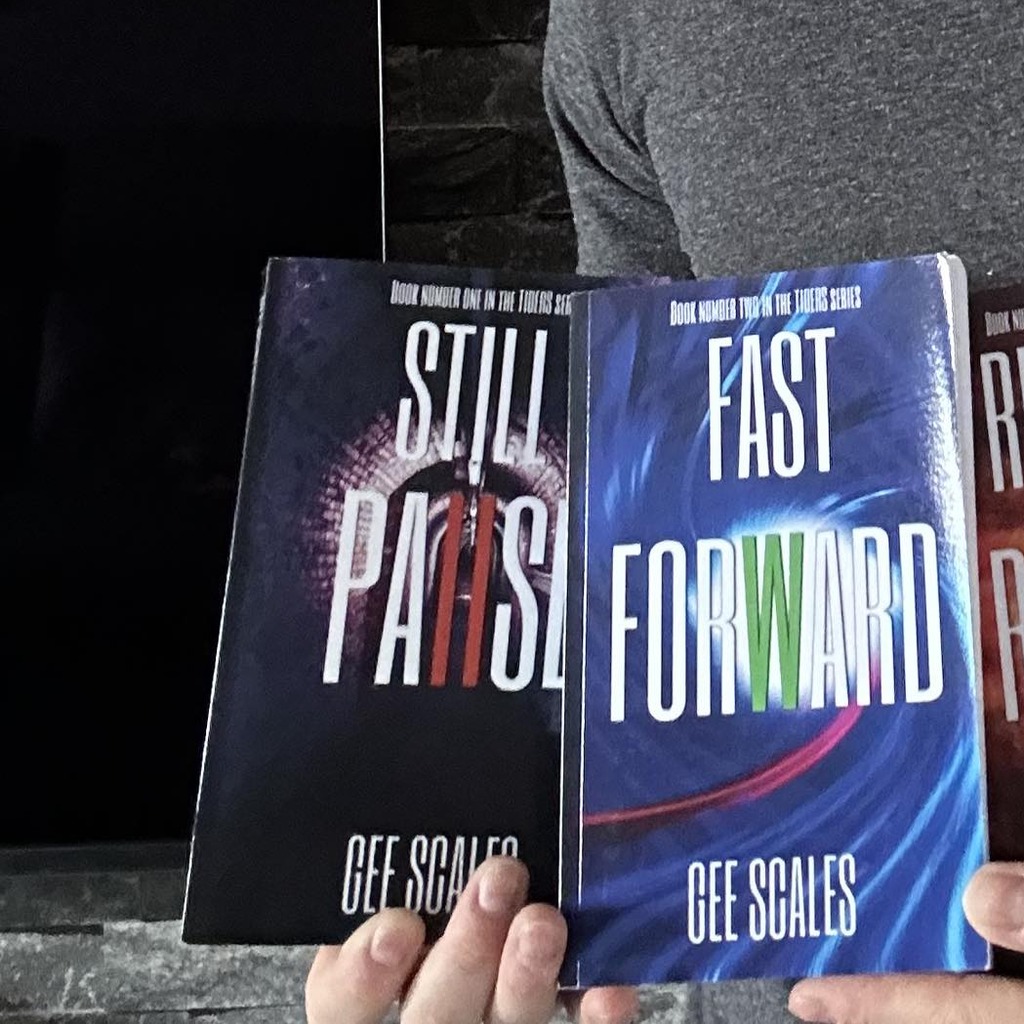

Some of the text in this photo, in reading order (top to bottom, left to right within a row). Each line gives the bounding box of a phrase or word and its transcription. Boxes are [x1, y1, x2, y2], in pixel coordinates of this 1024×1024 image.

[390, 279, 419, 305] BOOK
[420, 283, 461, 308] NUMBER
[462, 287, 482, 311] ONE
[484, 288, 496, 311] IN
[498, 290, 515, 313] THE
[554, 293, 572, 316] SER
[670, 300, 696, 326] BOOK
[699, 298, 736, 324] NUMBER
[739, 295, 760, 319] TWO
[762, 294, 773, 318] IN
[775, 292, 792, 316] THE
[830, 285, 862, 311] SERIES
[984, 310, 1011, 337] BOOK
[395, 320, 548, 466] STILL
[708, 327, 835, 481] FAST
[610, 522, 945, 723] FORWARD
[341, 834, 519, 915] GEE SCA
[687, 852, 857, 945] GEE SCALES
